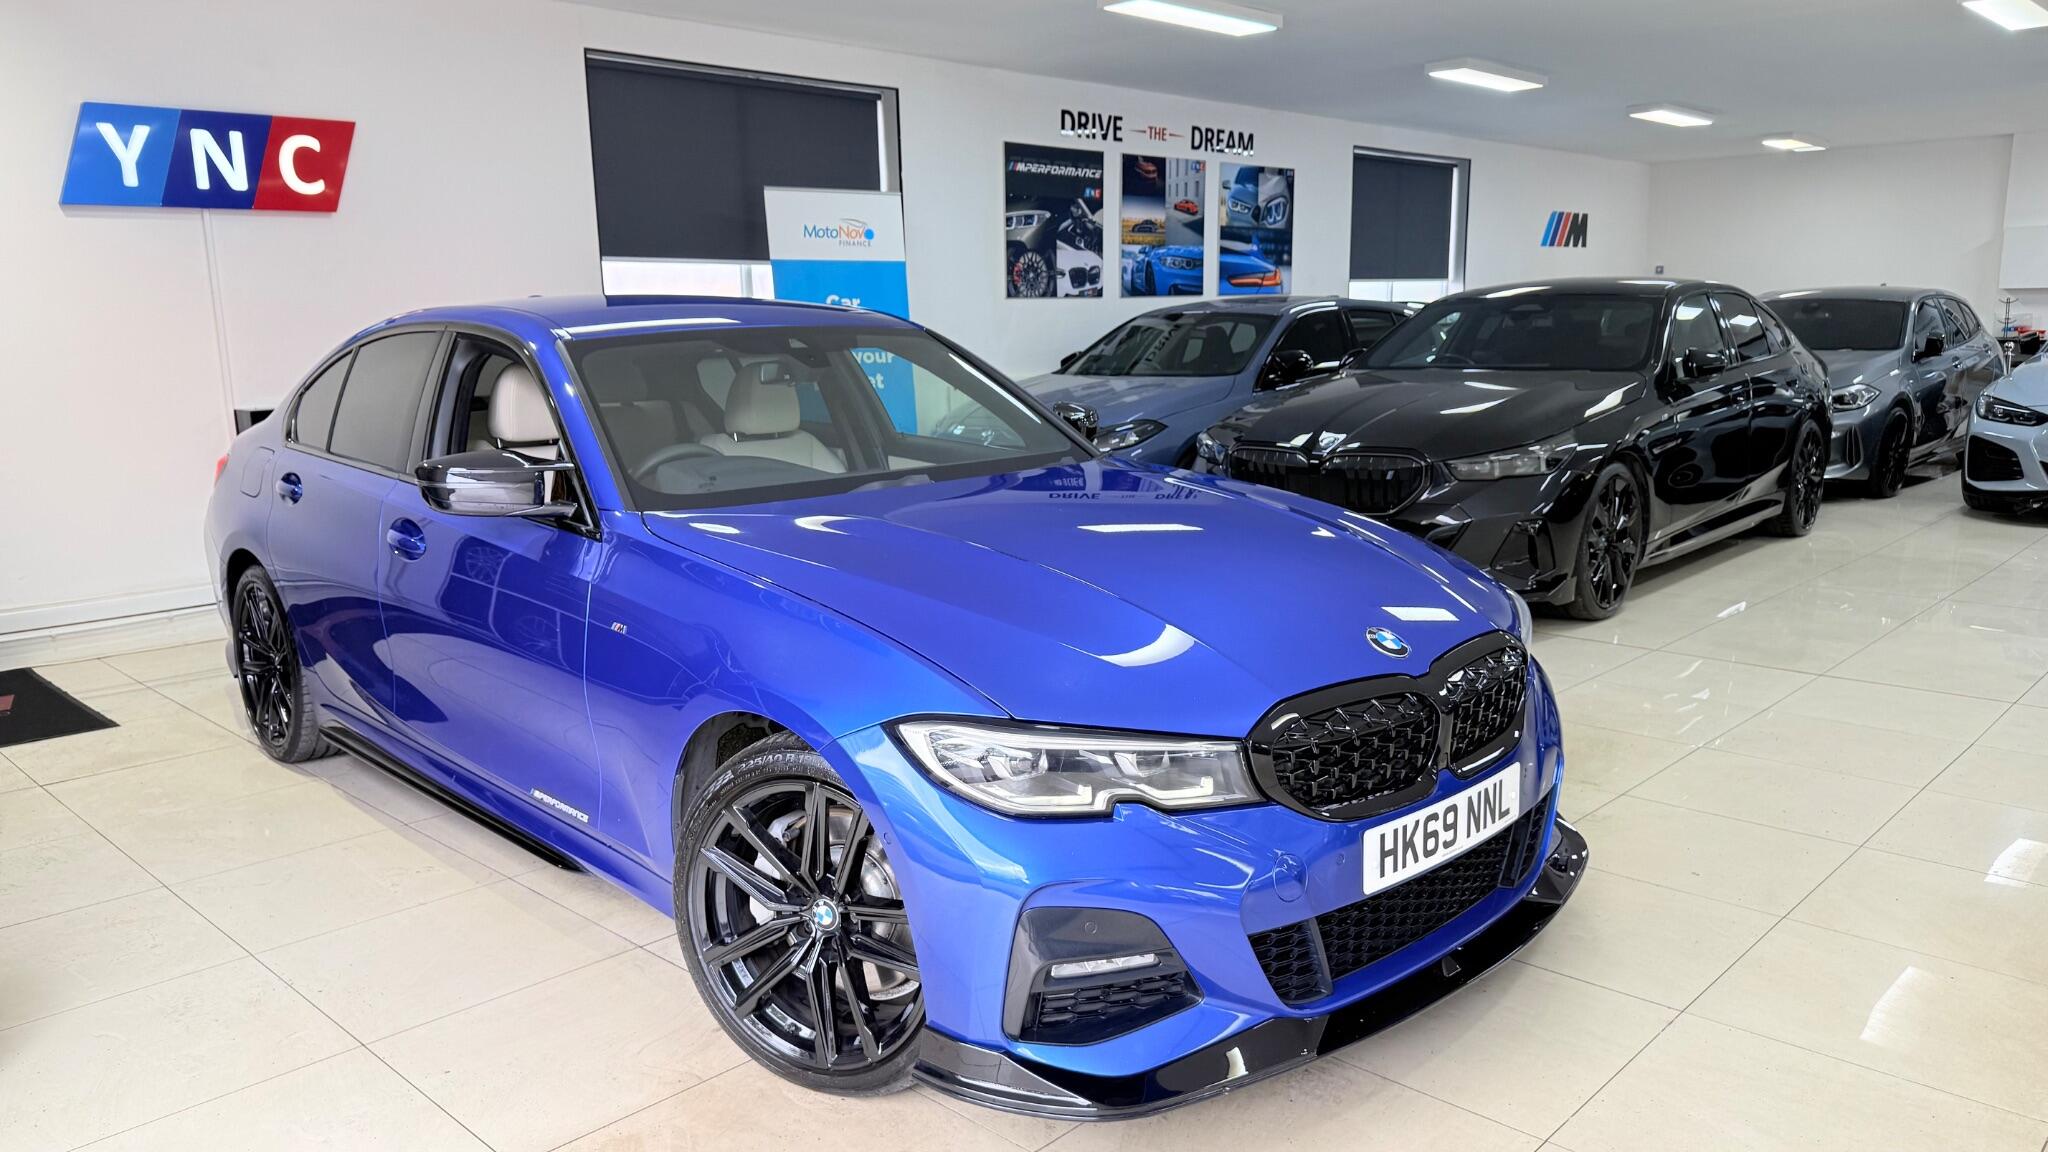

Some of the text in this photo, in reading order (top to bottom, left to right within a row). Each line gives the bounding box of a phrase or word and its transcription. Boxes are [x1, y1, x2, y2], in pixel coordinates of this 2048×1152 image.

[95, 121, 326, 196] YNC
[1060, 108, 1254, 156] DRIVE THE DREAM
[838, 240, 872, 248] FINANCE
[1379, 779, 1510, 879] HK69 NNL
